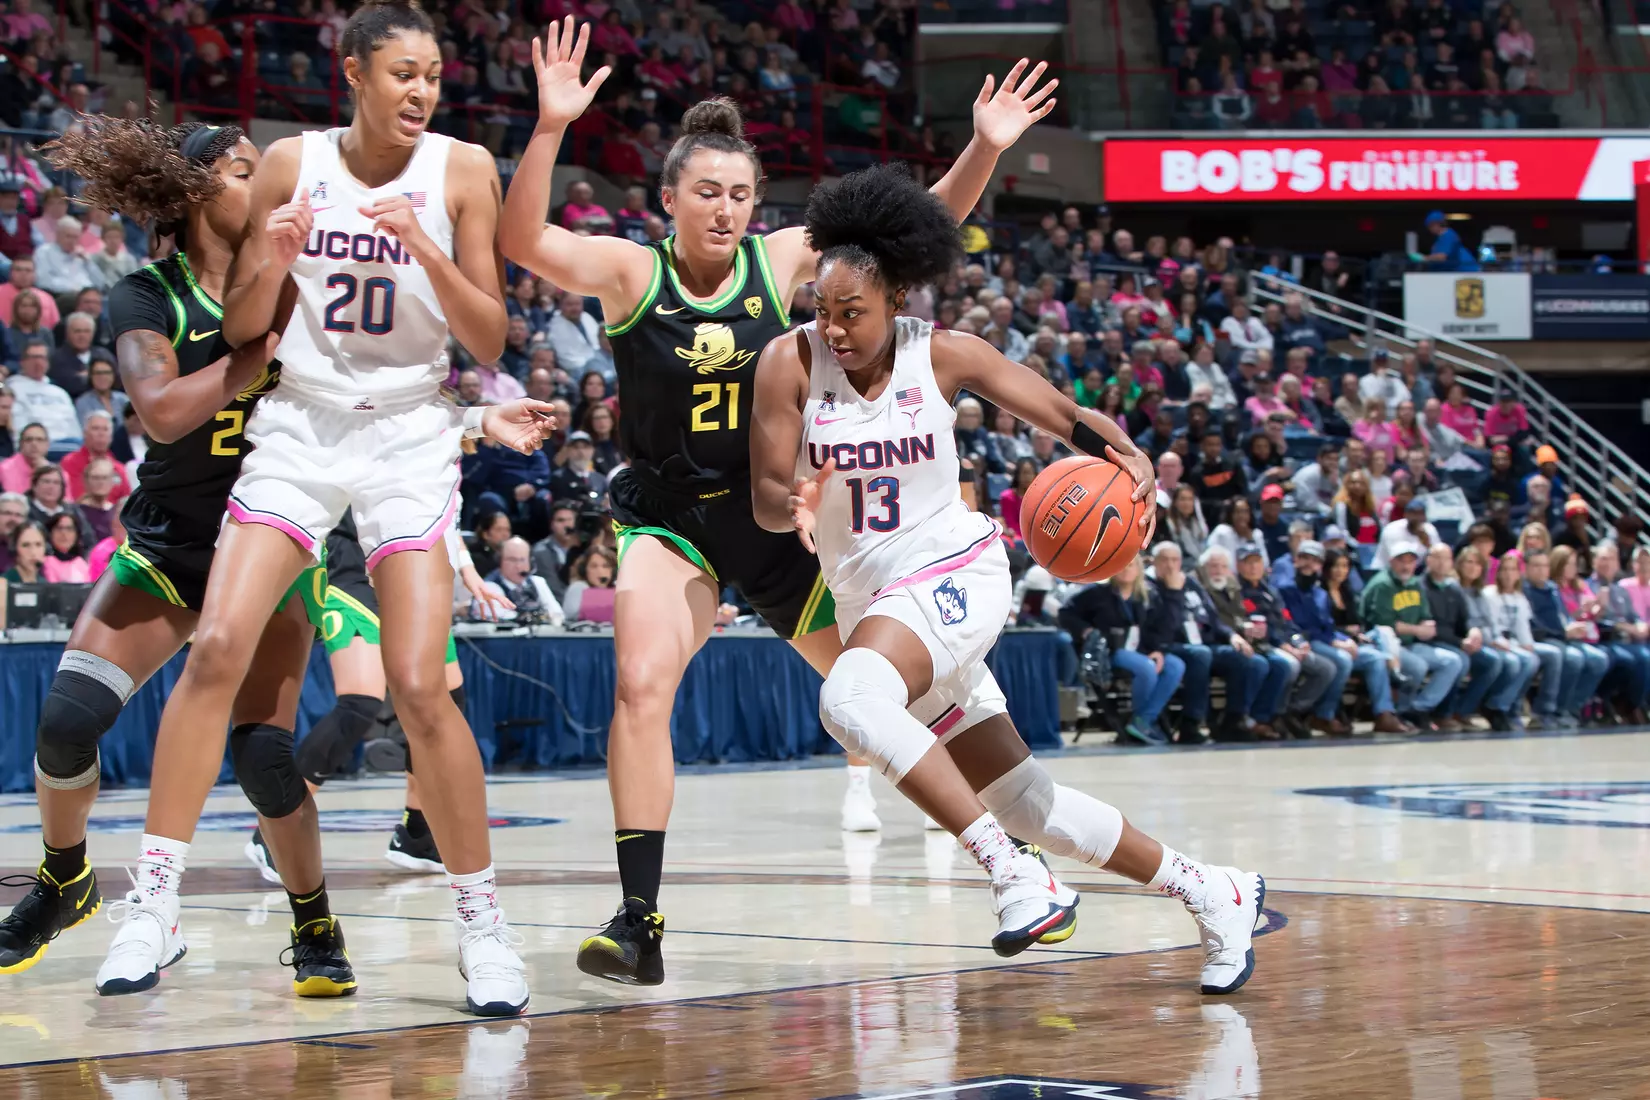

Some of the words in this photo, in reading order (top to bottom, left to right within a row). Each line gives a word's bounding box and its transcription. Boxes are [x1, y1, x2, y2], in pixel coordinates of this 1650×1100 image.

[1161, 148, 1325, 193] BOB'S
[1330, 160, 1520, 191] FURNITURE
[322, 273, 396, 335] 20
[692, 383, 740, 432] 21
[808, 433, 935, 471] UCONN
[699, 489, 730, 499] DUCKS
[845, 476, 900, 534] 13
[1042, 484, 1089, 539] ELITE
